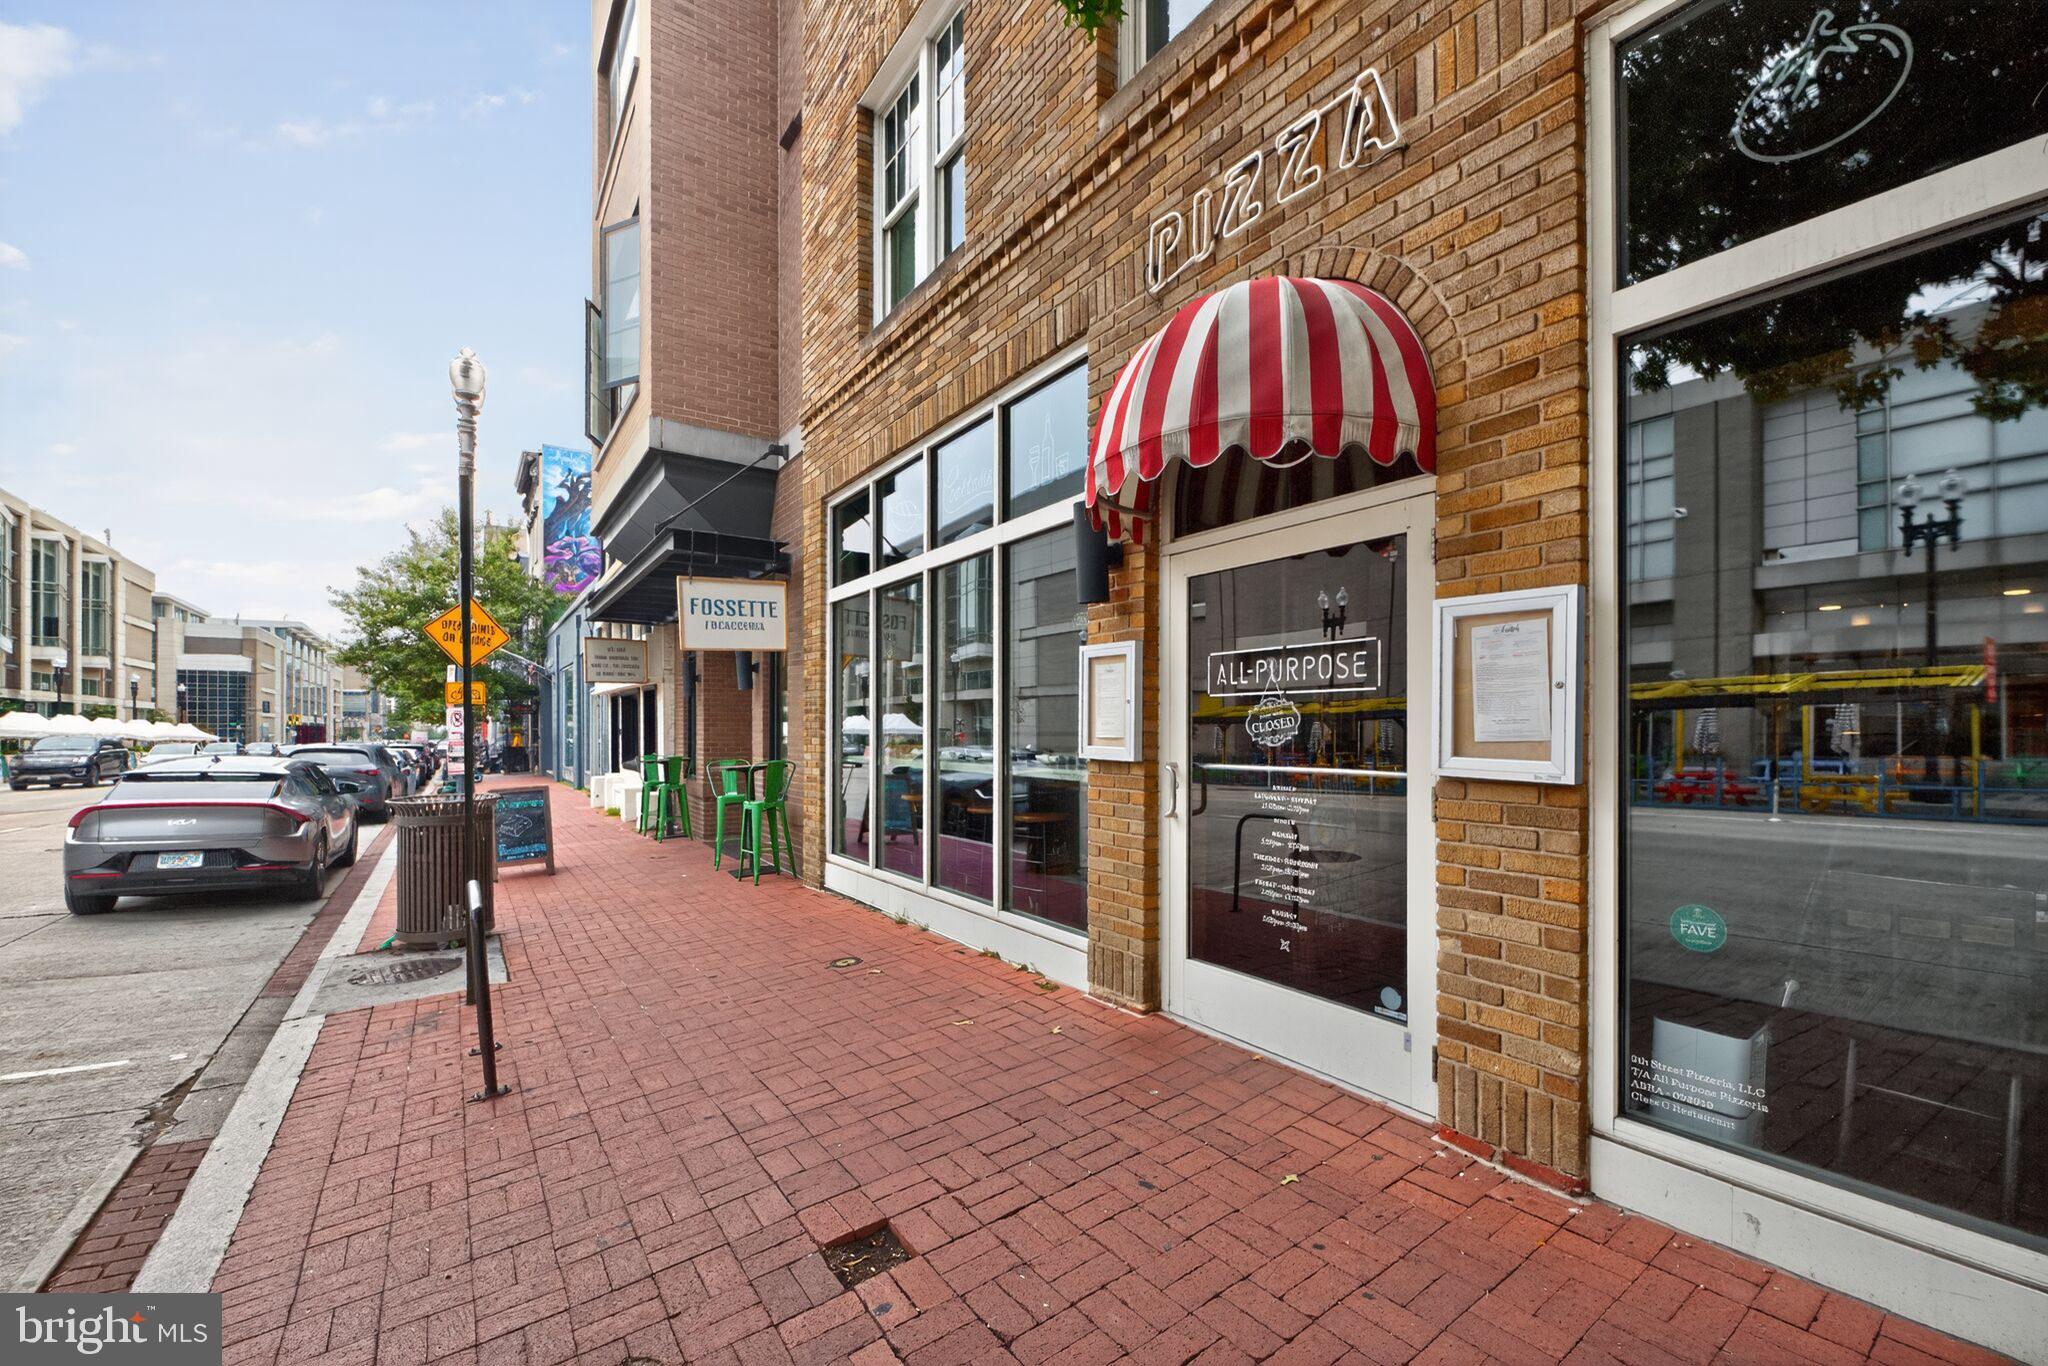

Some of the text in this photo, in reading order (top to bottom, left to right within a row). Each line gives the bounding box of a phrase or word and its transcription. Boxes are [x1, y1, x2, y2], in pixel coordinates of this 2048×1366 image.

[1148, 67, 1401, 293] PIZZA
[690, 597, 778, 618] FOSSETTE
[1216, 651, 1368, 686] ALL-PURPOSE
[1251, 716, 1295, 733] CLOSED
[1680, 923, 1717, 939] FAVE
[1631, 1067, 1769, 1113] T/A All Purpose Pizzeria
[1651, 1060, 1683, 1075] Street
[1738, 1083, 1766, 1099] LLC
[1672, 1103, 1736, 1130] Restaurant
